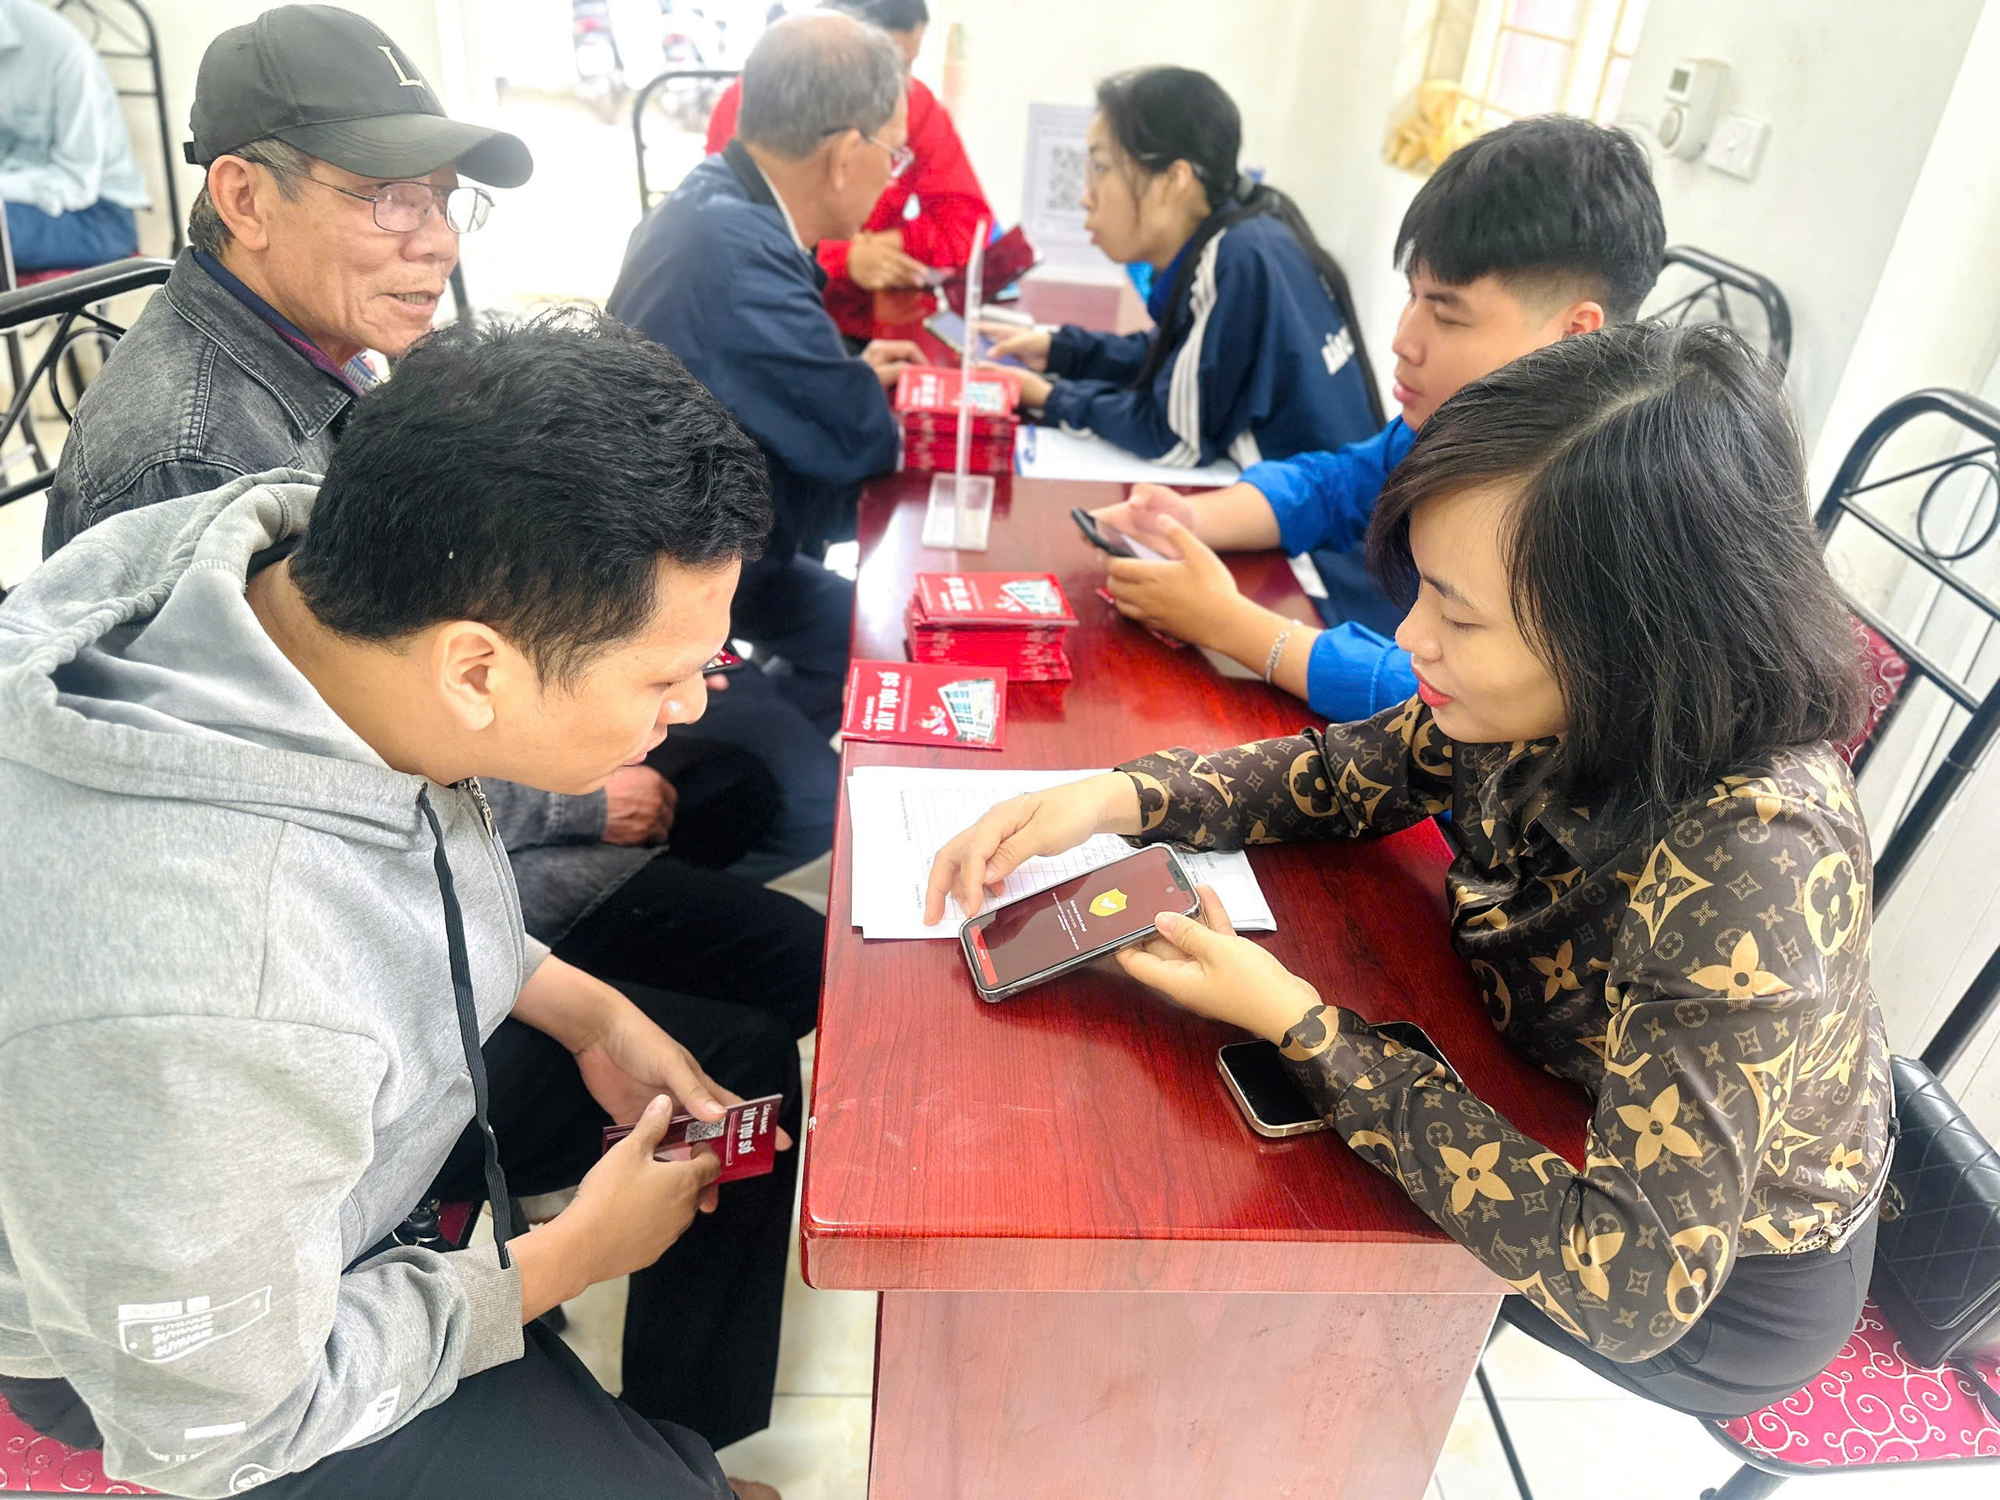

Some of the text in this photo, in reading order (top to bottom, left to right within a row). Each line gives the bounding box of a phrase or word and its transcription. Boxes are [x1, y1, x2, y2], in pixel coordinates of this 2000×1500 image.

[377, 46, 425, 89] L
[877, 671, 901, 688] SỐ
[738, 1140, 756, 1154] SỐ
